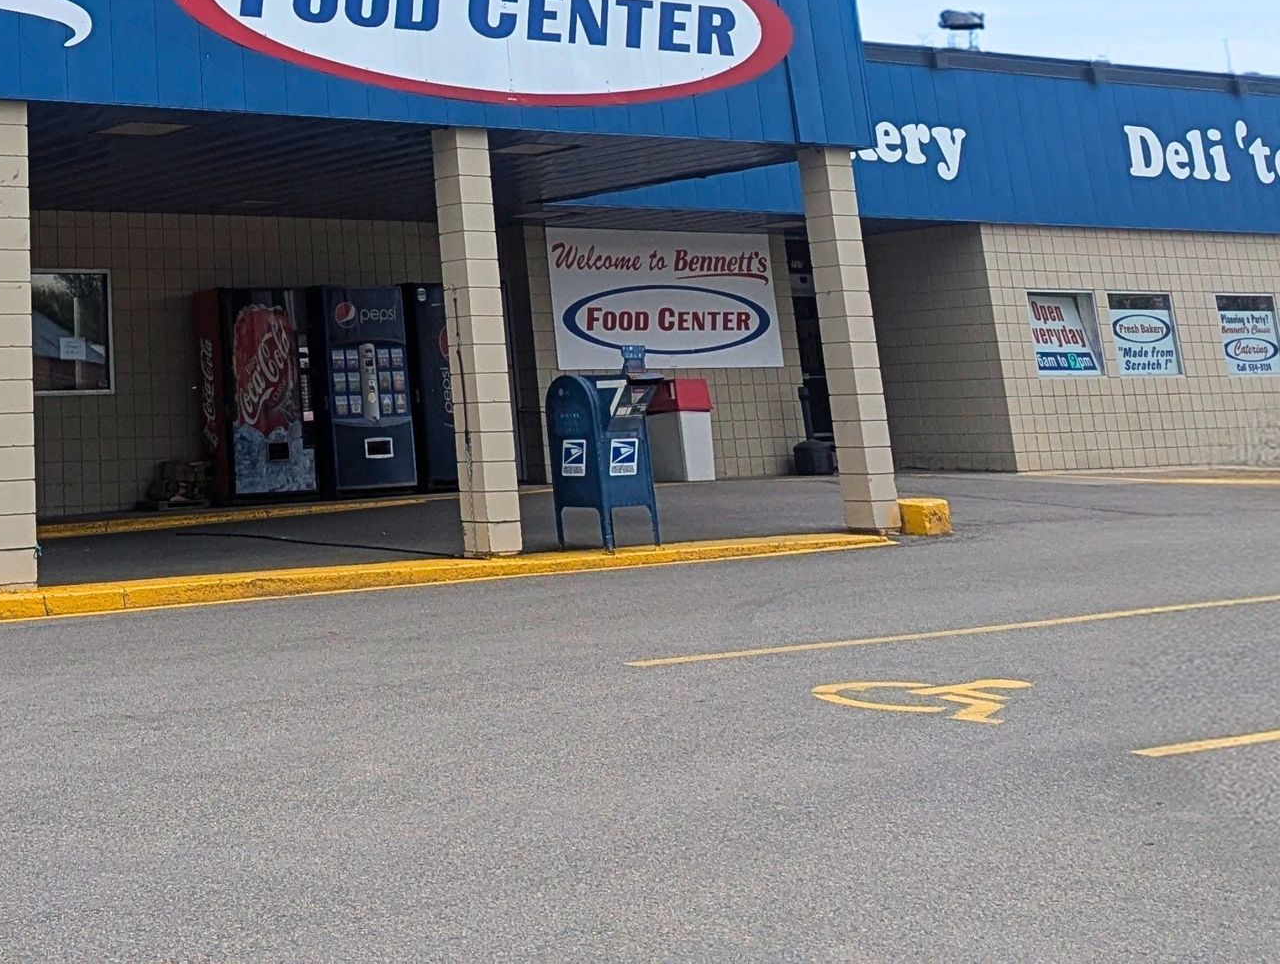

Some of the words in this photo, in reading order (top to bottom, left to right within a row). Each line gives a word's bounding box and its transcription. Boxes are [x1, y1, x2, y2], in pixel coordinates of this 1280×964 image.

[850, 121, 967, 181] ery
[1123, 124, 1231, 182] Deli
[1235, 119, 1280, 184] 't
[551, 242, 644, 271] Welcome
[649, 249, 668, 271] to
[673, 249, 768, 274] Bennett's
[359, 306, 397, 323] pepsi
[586, 307, 649, 331] FOOD
[657, 307, 751, 331] CENTER
[1031, 300, 1065, 324] Open
[1119, 324, 1139, 334] Fresh
[1140, 324, 1164, 335] Bakery
[1151, 346, 1174, 358] from
[1234, 340, 1269, 359] Catering
[1057, 355, 1068, 367] to
[1124, 359, 1162, 371] Scratch
